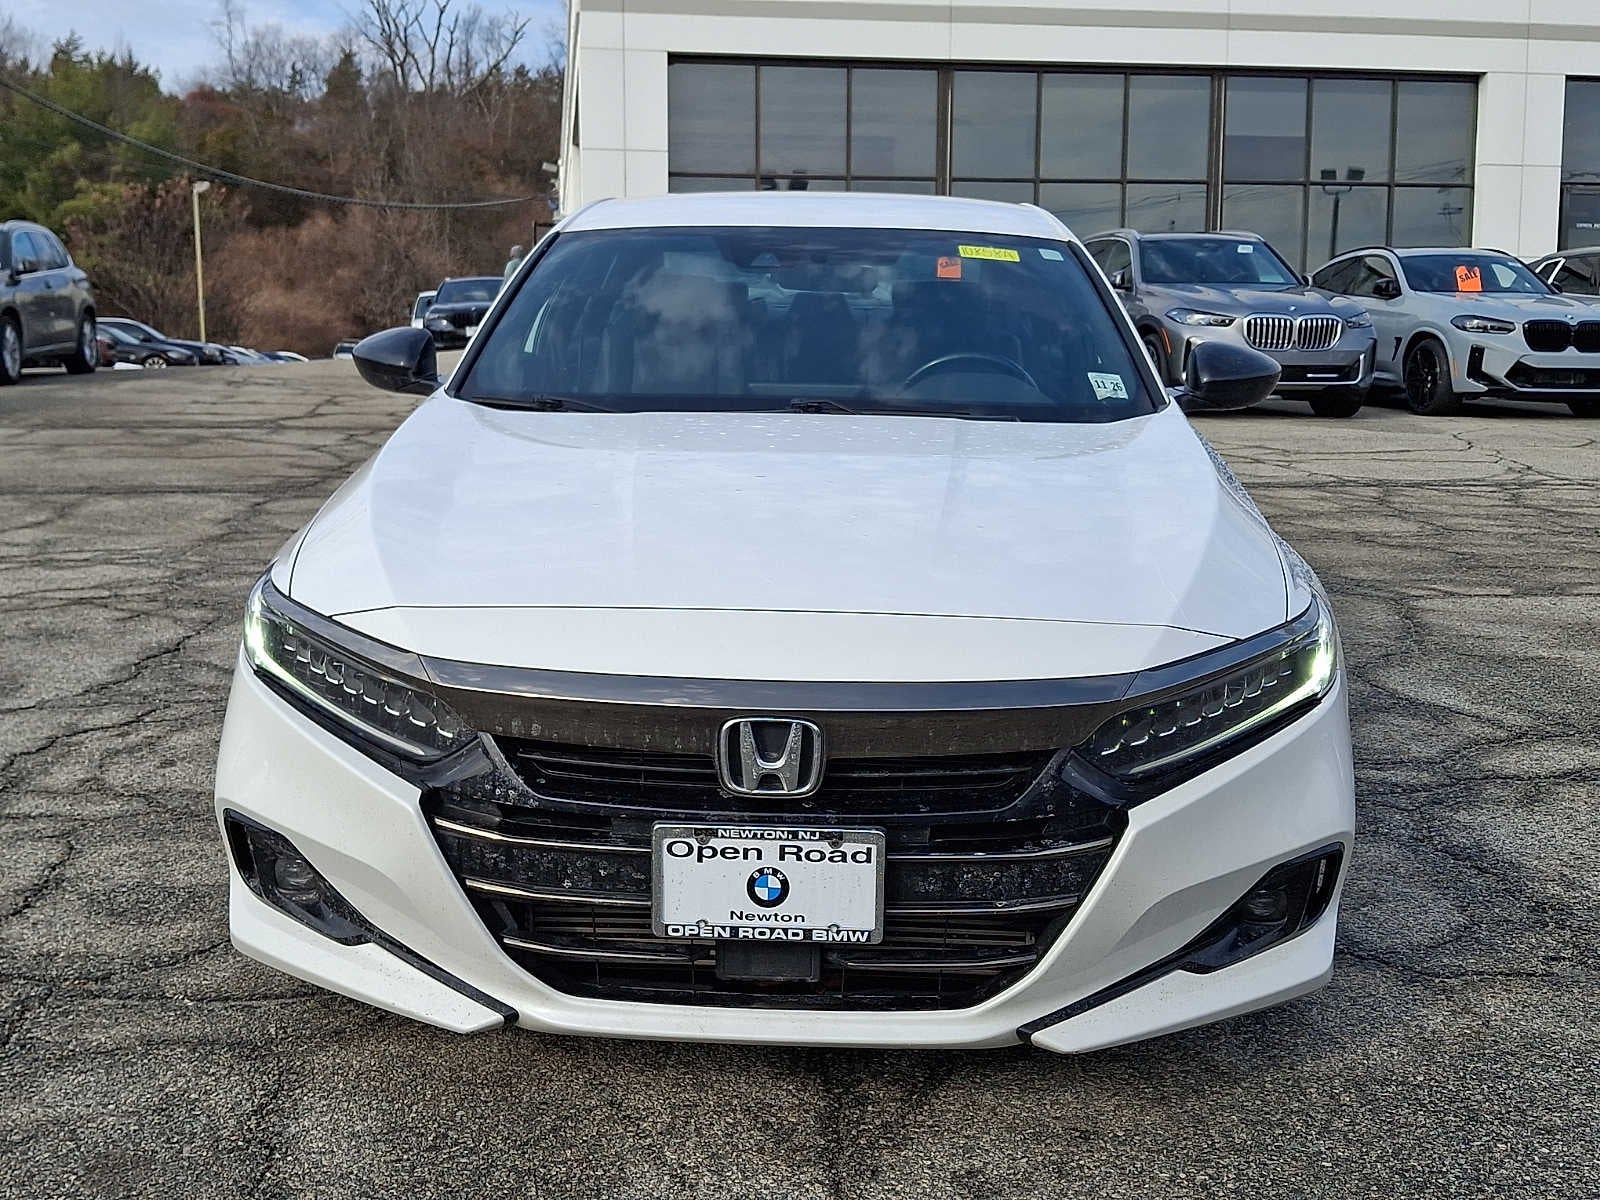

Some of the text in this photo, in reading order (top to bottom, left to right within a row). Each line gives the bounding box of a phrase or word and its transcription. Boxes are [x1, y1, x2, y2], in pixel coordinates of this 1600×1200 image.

[1095, 380, 1122, 391] 11 26
[798, 831, 820, 840] NJ
[666, 840, 873, 864] Open Road
[753, 867, 785, 881] BMW
[730, 910, 805, 923] Newton
[667, 924, 869, 942] OPEN ROAD BMW
